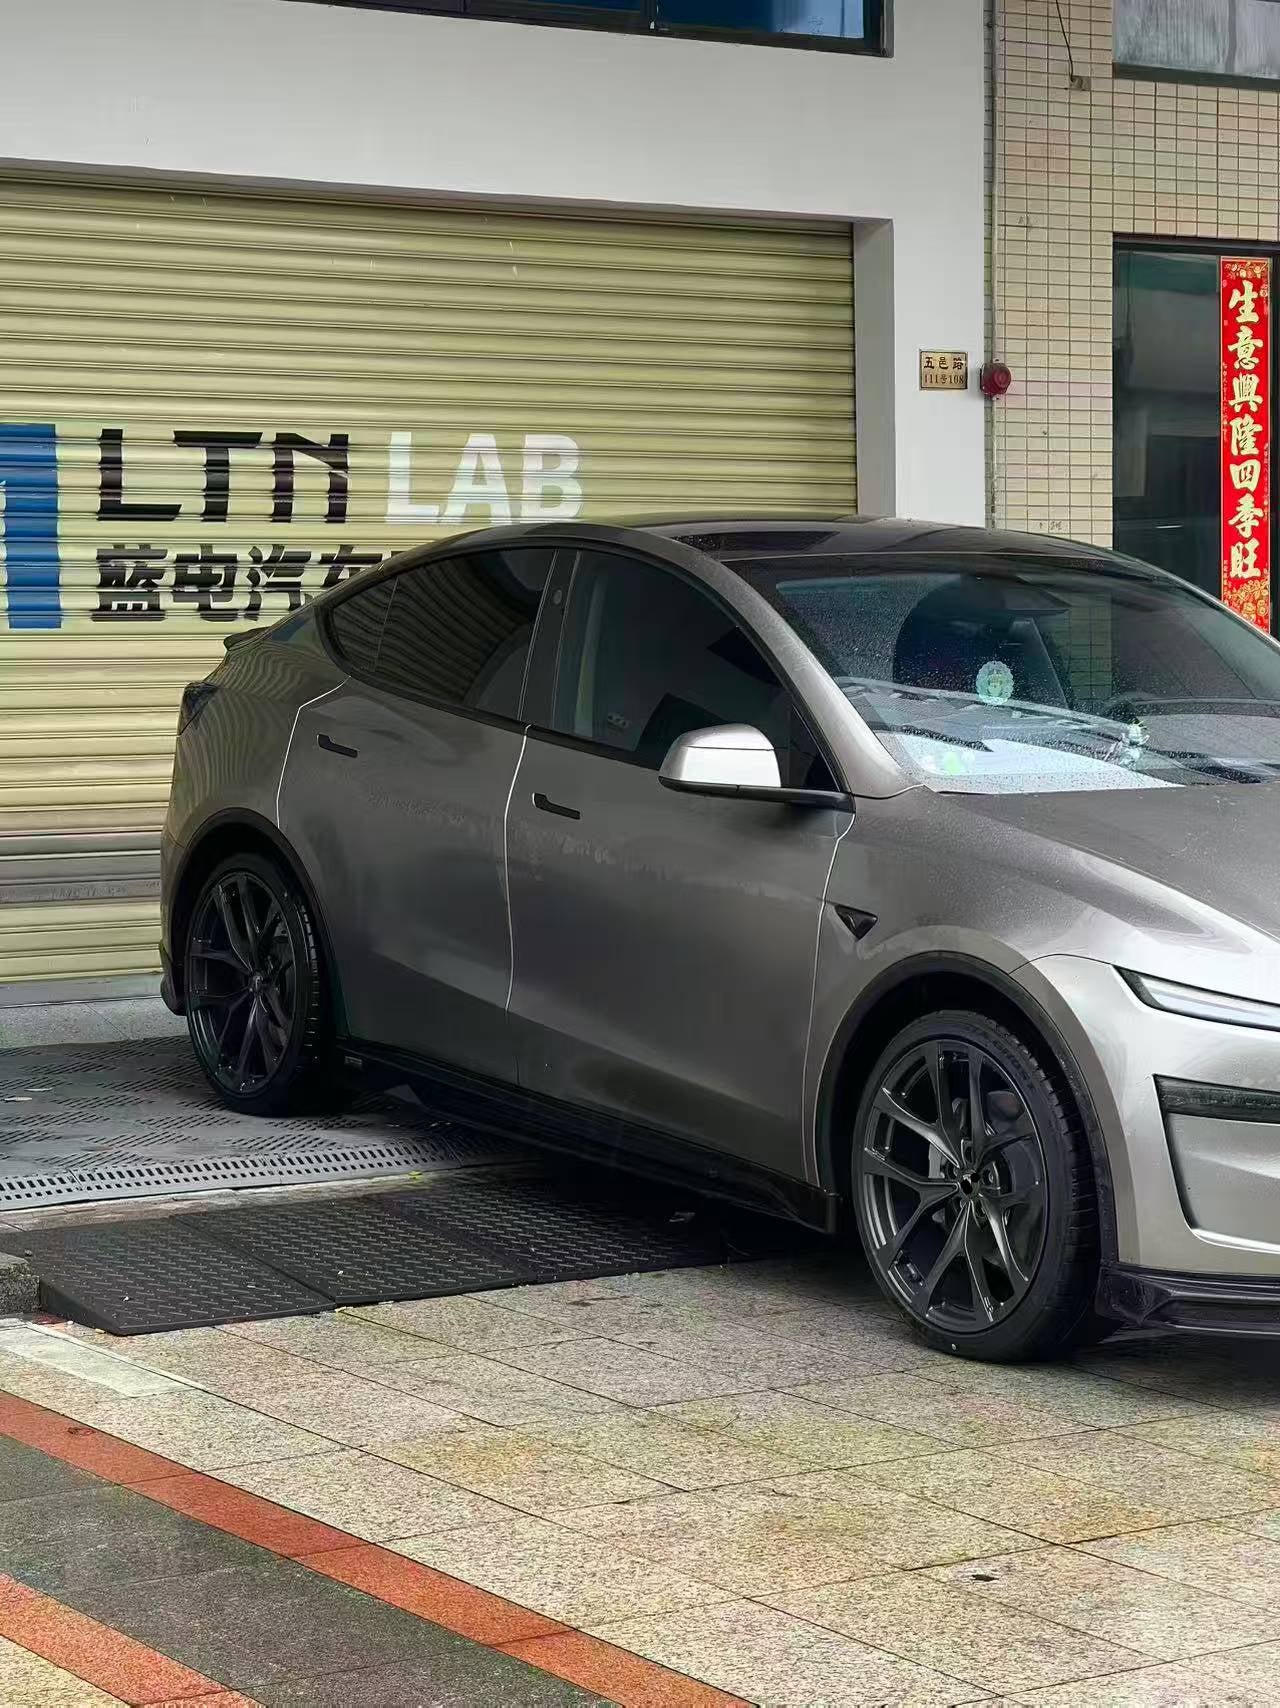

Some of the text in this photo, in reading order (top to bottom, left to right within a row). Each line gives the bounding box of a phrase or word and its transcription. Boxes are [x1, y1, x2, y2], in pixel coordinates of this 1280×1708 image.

[96, 428, 583, 524] LTN LAB
[1227, 279, 1264, 578] 生意興隆四季旺
[89, 544, 403, 622] 蓝电汽车
